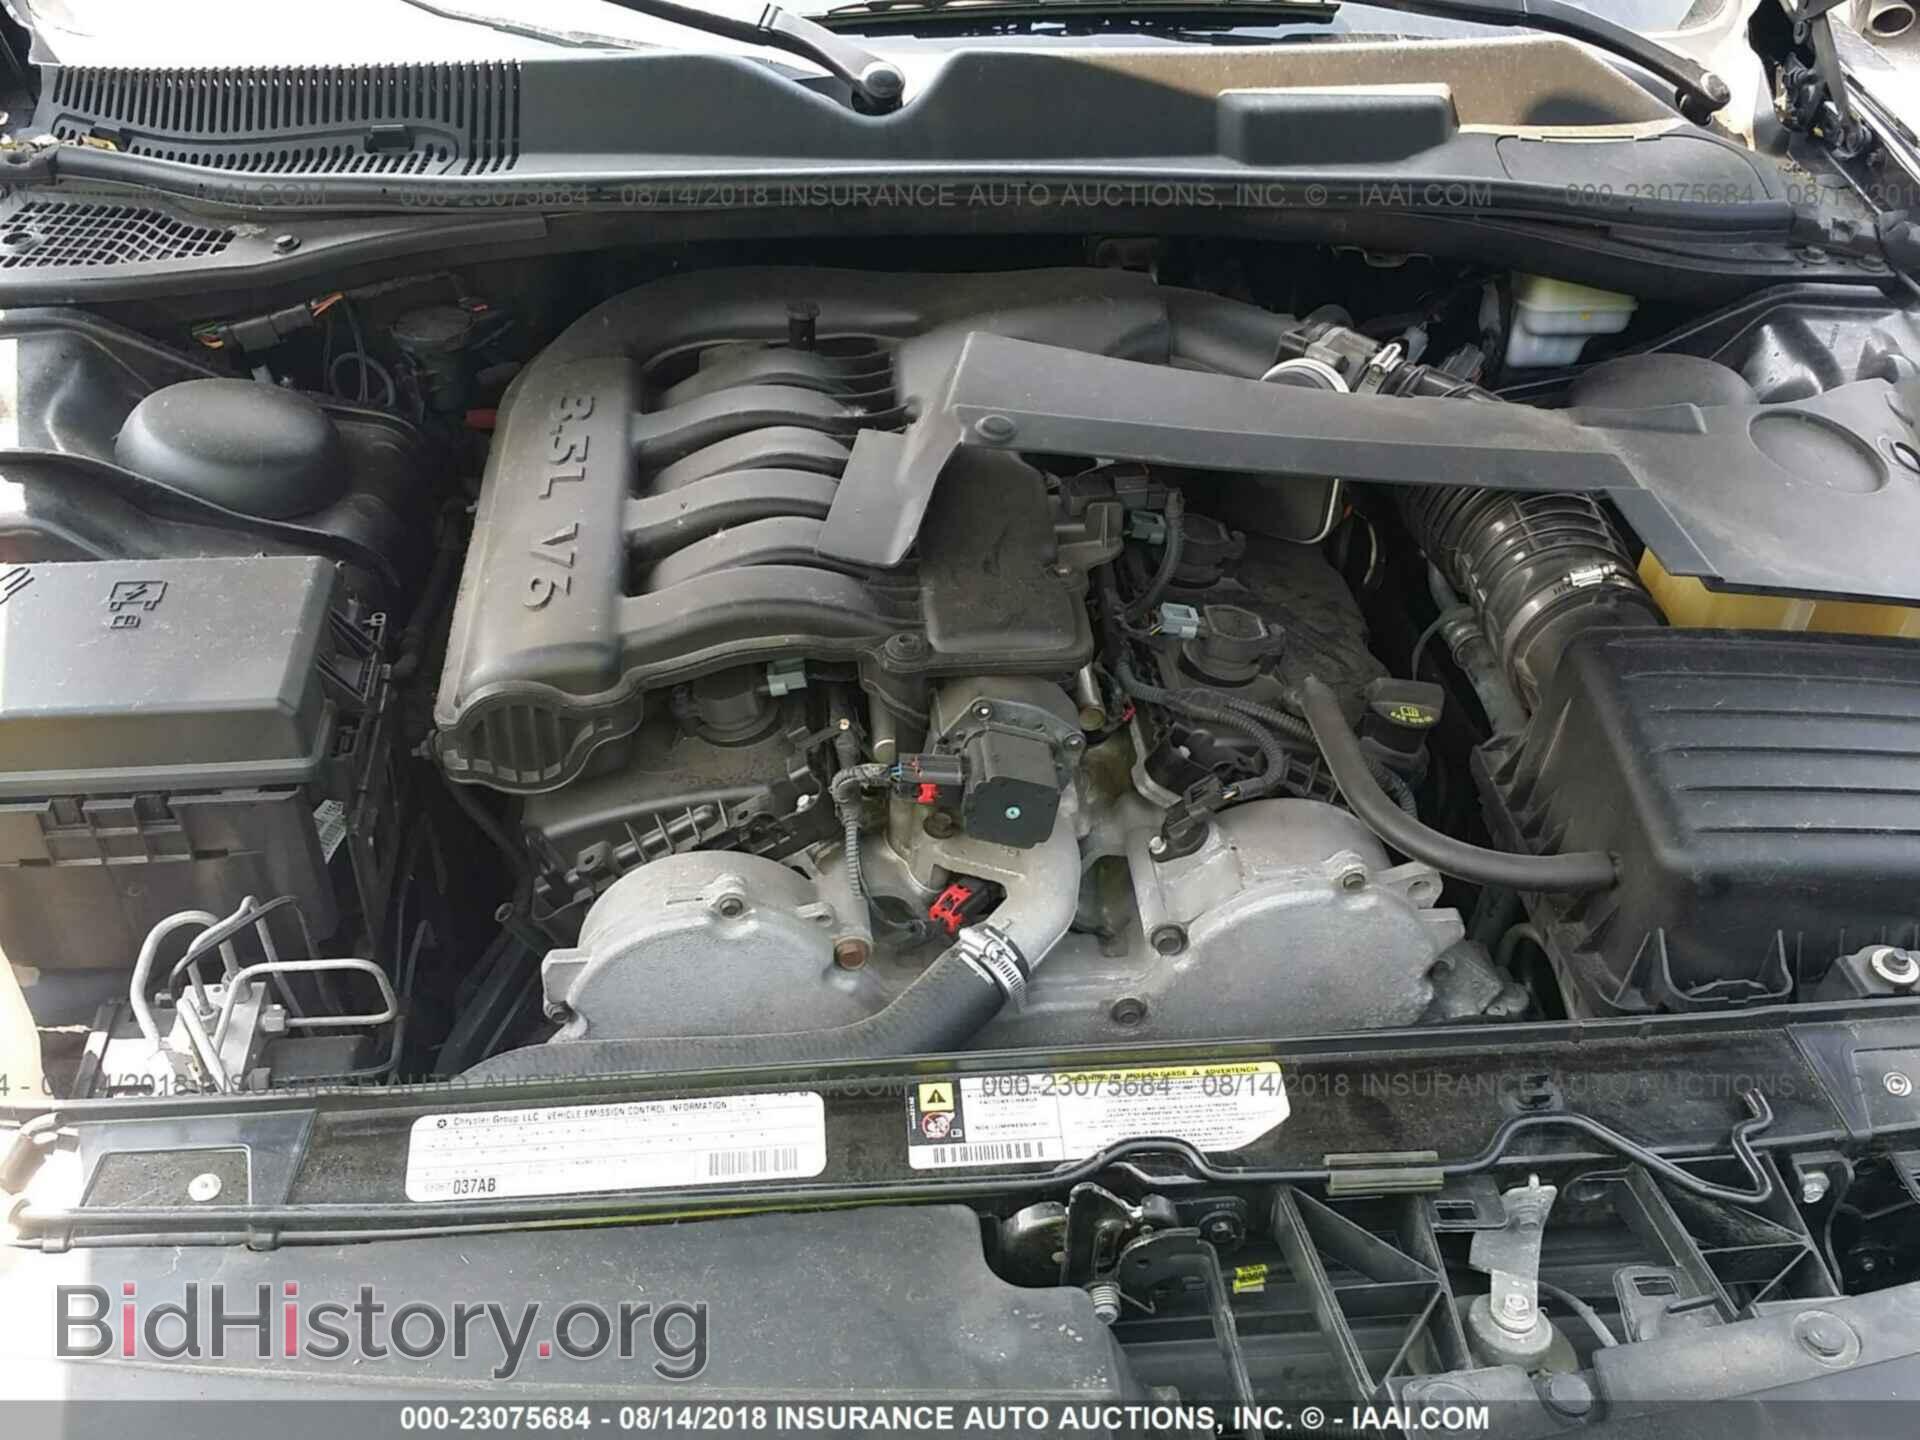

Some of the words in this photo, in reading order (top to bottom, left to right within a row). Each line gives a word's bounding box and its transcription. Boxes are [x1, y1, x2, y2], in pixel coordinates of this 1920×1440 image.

[538, 397, 596, 500] 3.5L
[523, 521, 581, 612] V6
[584, 1106, 625, 1118] EMISSION
[628, 1104, 665, 1116] CONTROL
[669, 1101, 728, 1113] INFORMATION
[453, 1177, 497, 1195] 037AB
